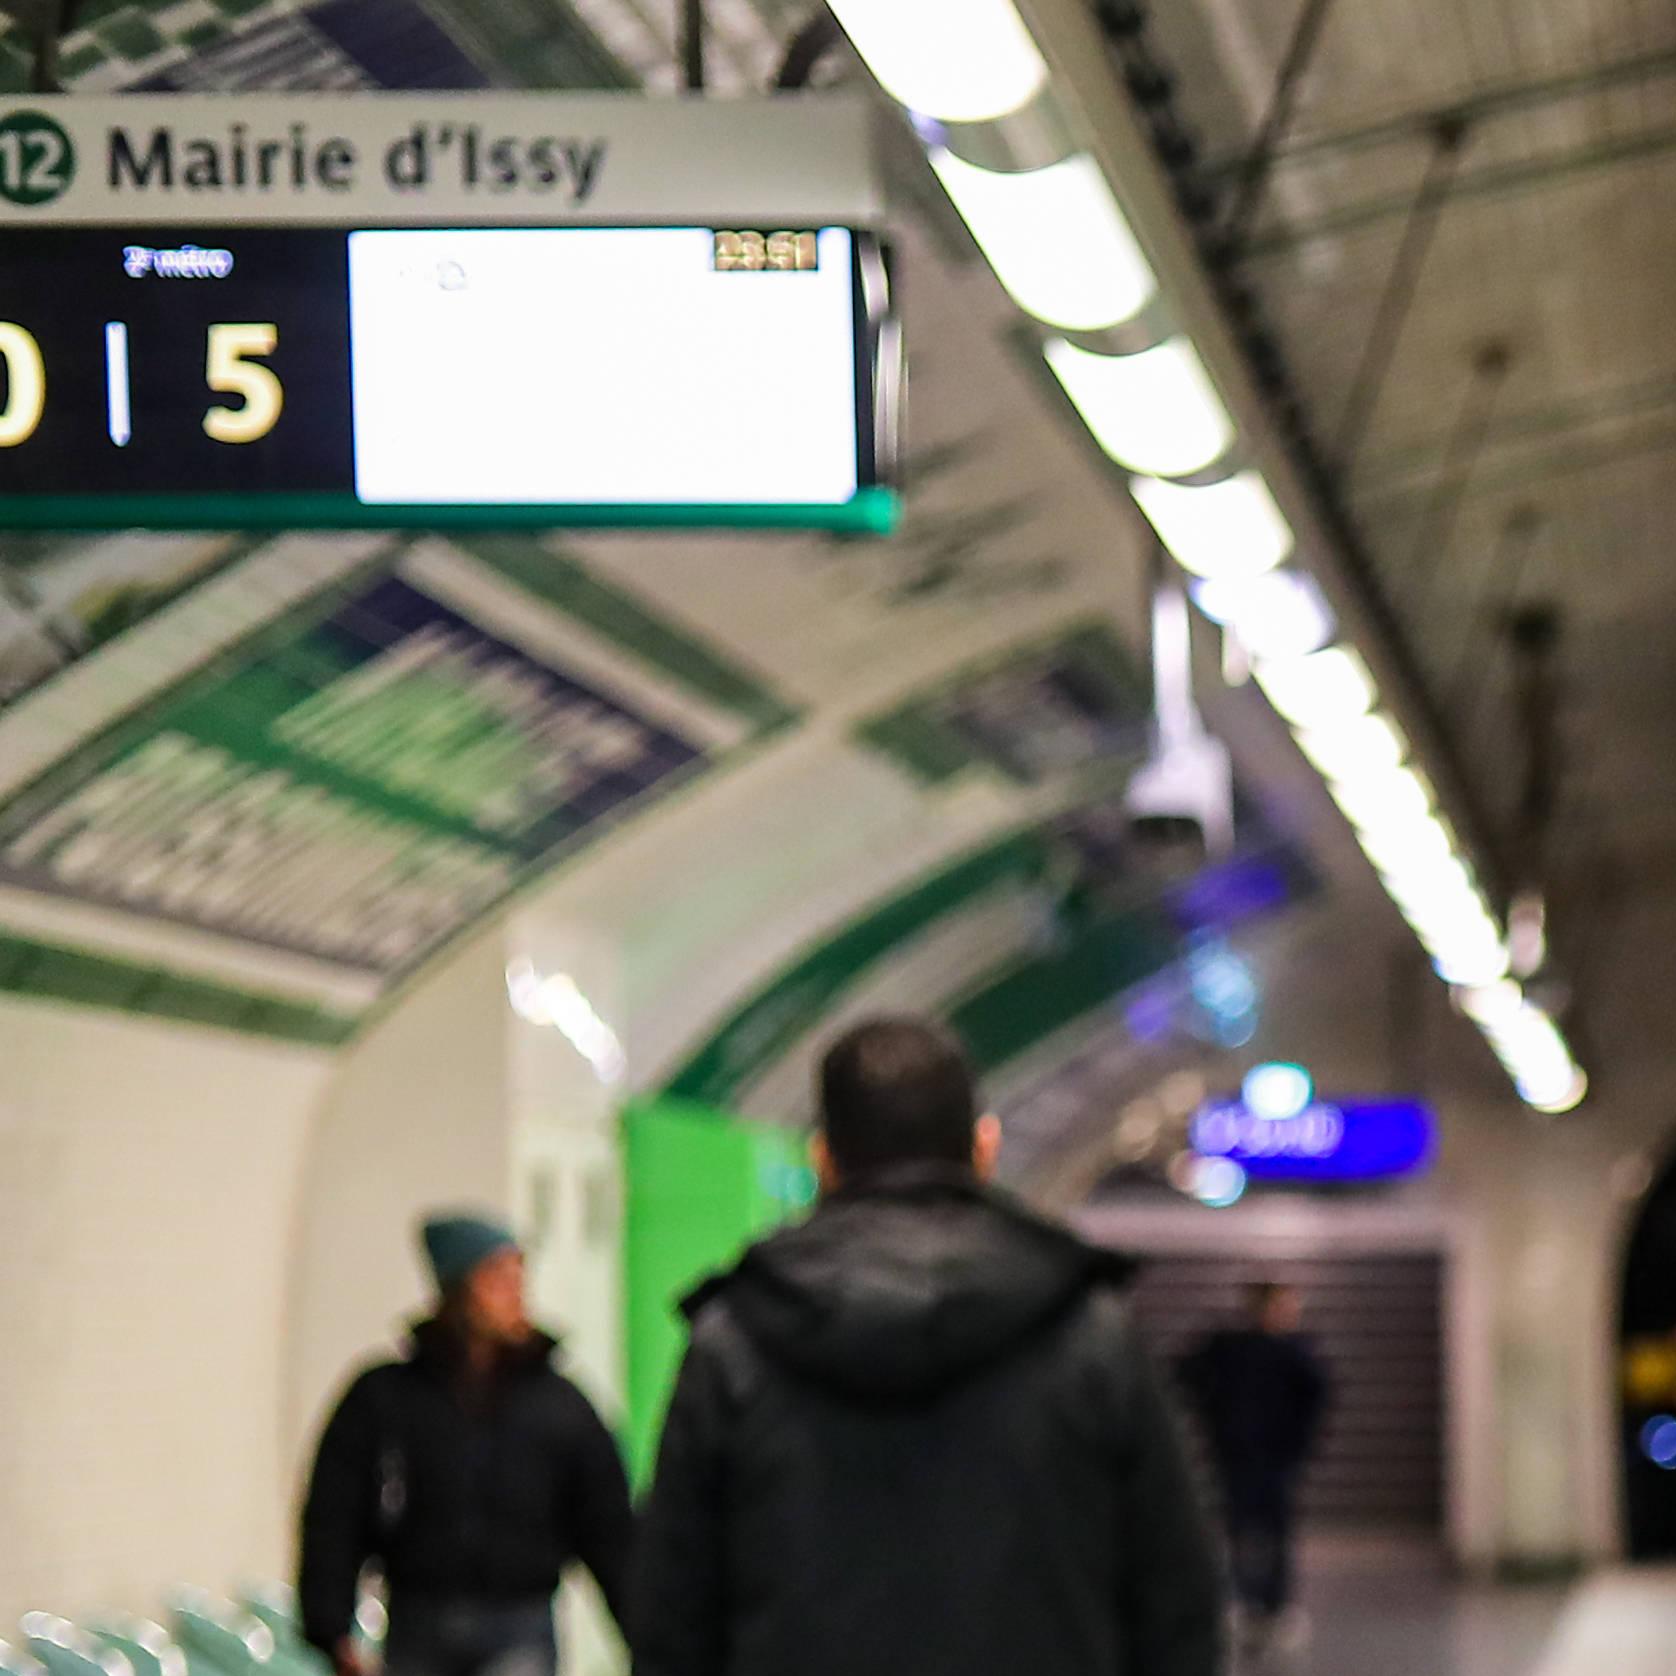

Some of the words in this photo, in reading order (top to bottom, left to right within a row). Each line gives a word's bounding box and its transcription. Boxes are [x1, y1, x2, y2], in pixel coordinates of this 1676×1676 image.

[0, 129, 62, 190] 12
[107, 123, 356, 191] Mairie
[383, 120, 605, 208] d'Issy
[202, 321, 283, 444] 5
